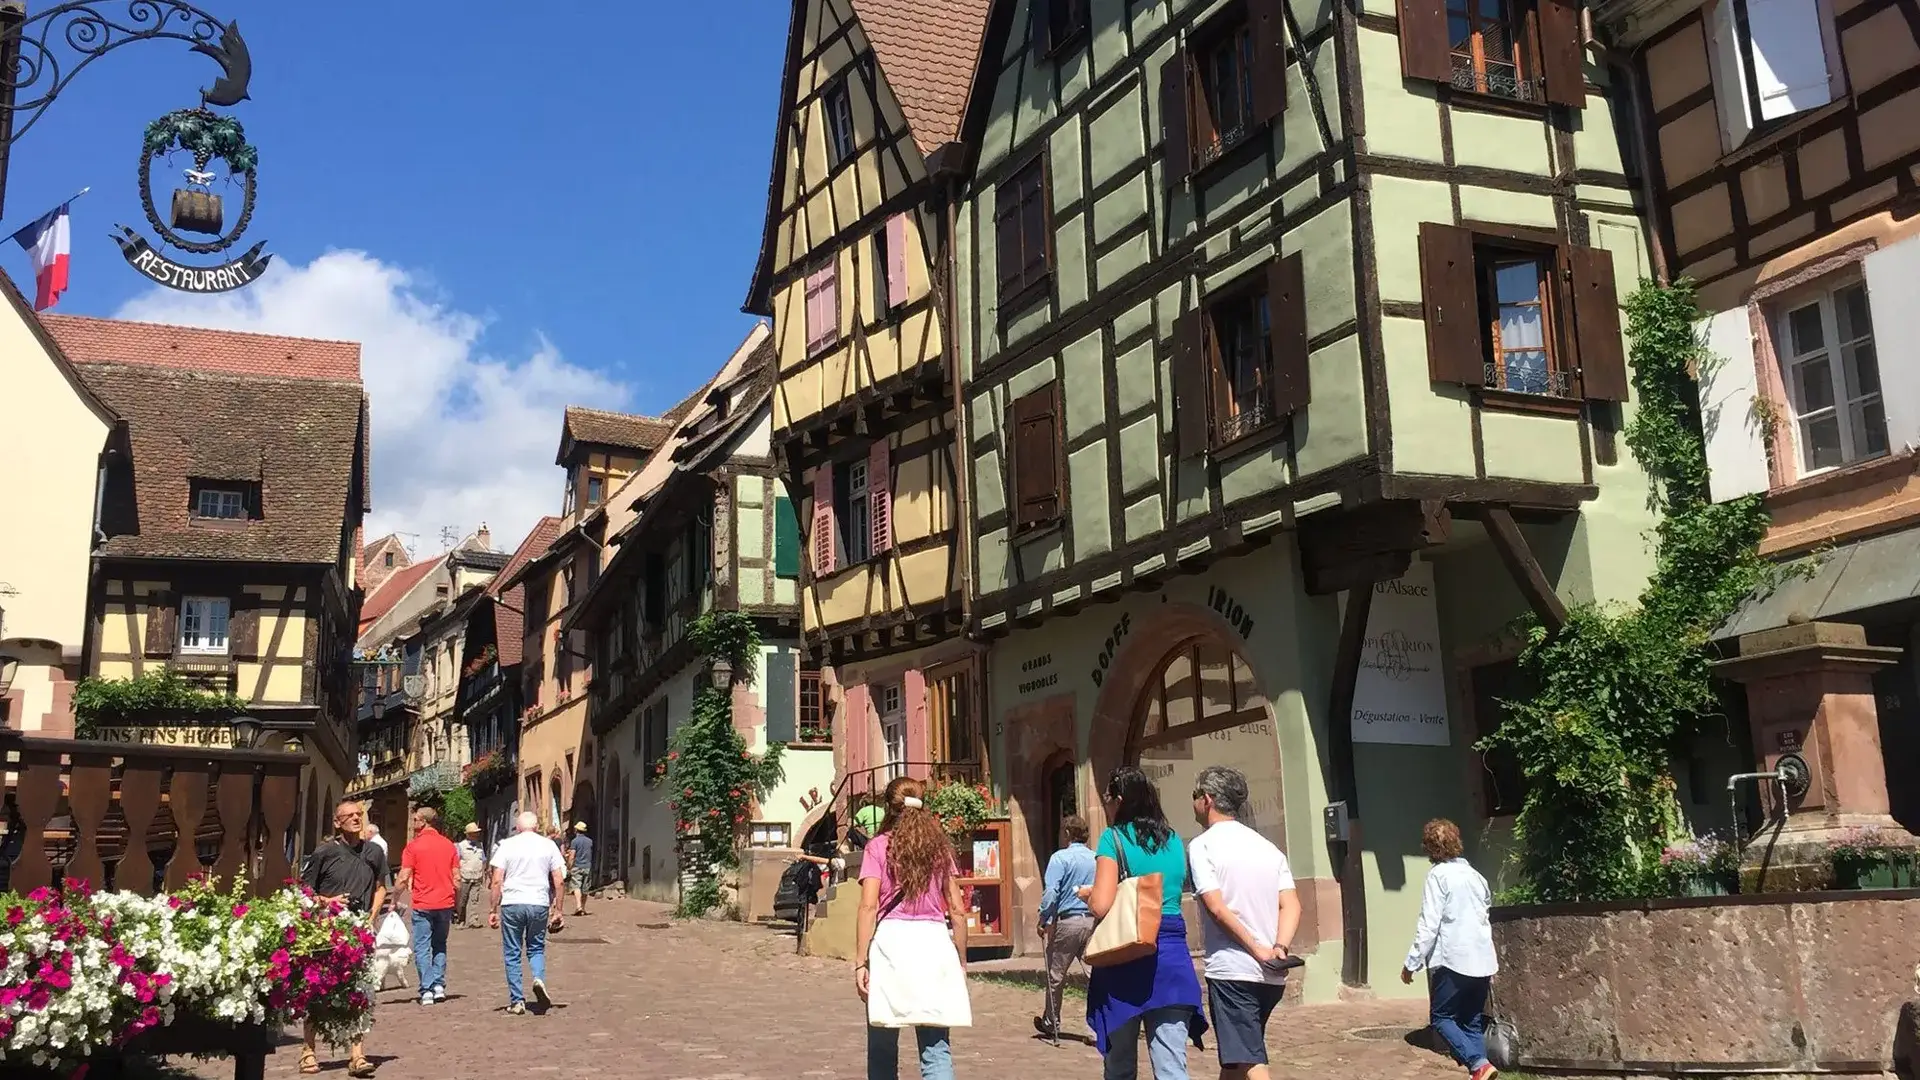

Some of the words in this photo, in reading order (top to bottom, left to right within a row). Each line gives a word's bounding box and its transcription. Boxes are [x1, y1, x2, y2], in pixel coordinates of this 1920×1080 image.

[133, 249, 251, 291] RESTAURANT
[1375, 580, 1428, 597] d'Alsace
[1091, 612, 1131, 688] DOPFF
[1207, 585, 1254, 640] IRION
[1022, 652, 1052, 672] GRANDS
[1018, 673, 1058, 694] VIGNOBLES
[1354, 707, 1411, 724] Dégustation
[1419, 713, 1445, 725] Vente
[93, 728, 131, 743] VINS
[139, 728, 178, 745] FINS
[184, 728, 230, 745] HUGE
